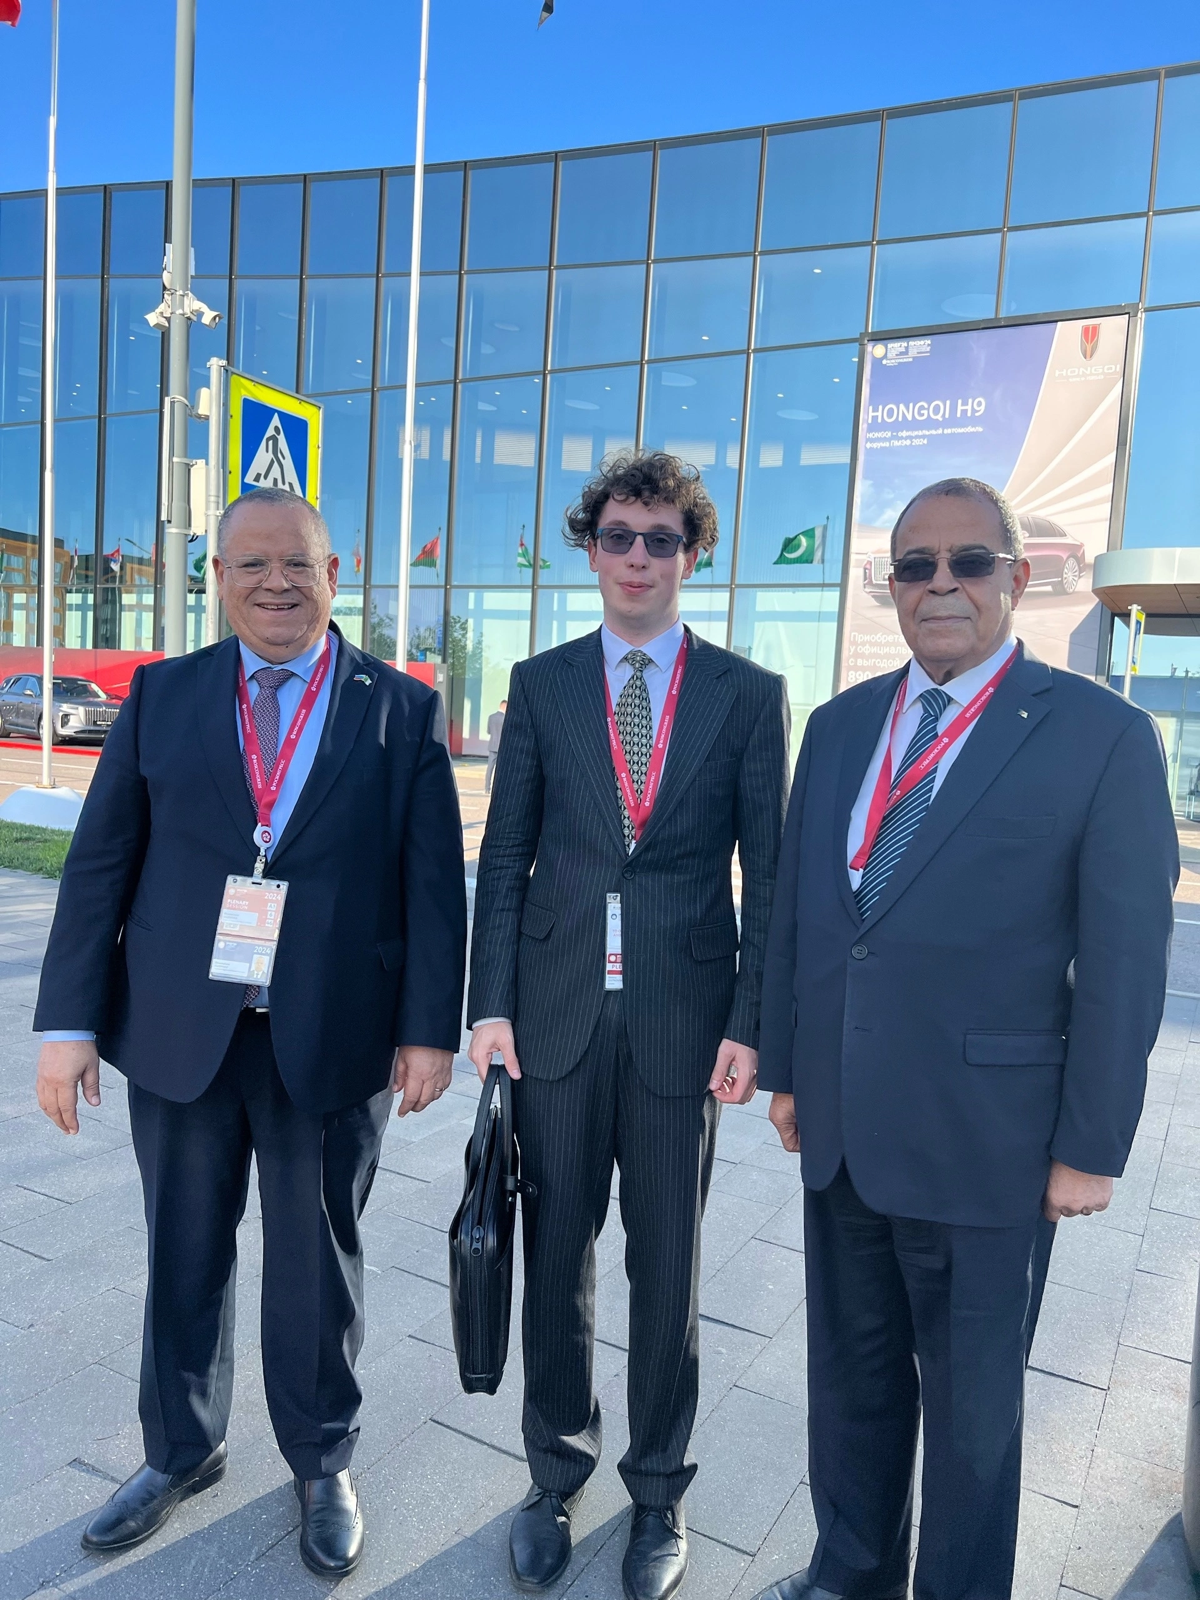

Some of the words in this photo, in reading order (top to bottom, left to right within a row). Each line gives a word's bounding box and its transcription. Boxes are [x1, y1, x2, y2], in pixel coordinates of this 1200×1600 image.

[1055, 364, 1119, 377] HONGQI
[868, 400, 950, 424] HONGQI
[957, 397, 986, 418] H9
[867, 431, 891, 439] HONGQI
[898, 428, 943, 438] официальный
[944, 426, 983, 435] автомобиль
[866, 441, 889, 449] форума
[891, 439, 911, 447] ПМЭФ
[849, 646, 855, 655] у
[848, 658, 855, 666] с
[857, 657, 900, 669] выгодой
[264, 892, 281, 901] 2024
[253, 946, 271, 954] 2024
